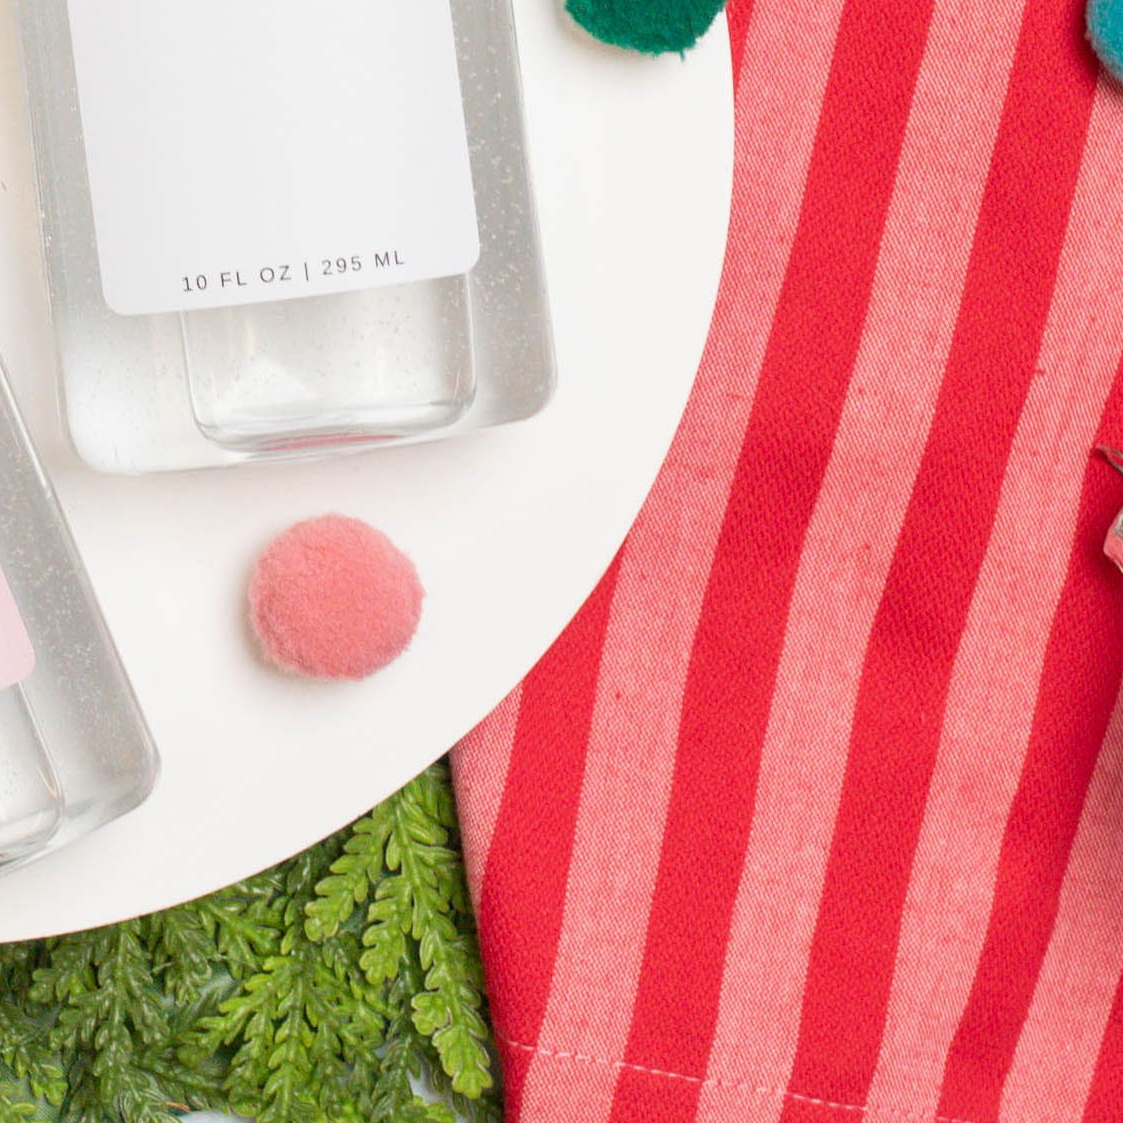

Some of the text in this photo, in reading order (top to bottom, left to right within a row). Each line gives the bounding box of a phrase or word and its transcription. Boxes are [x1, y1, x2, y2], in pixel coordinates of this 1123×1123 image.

[182, 274, 208, 293] 10
[220, 271, 248, 289] FL
[259, 264, 292, 284] OZ
[321, 255, 362, 276] 295
[373, 249, 405, 268] ML
